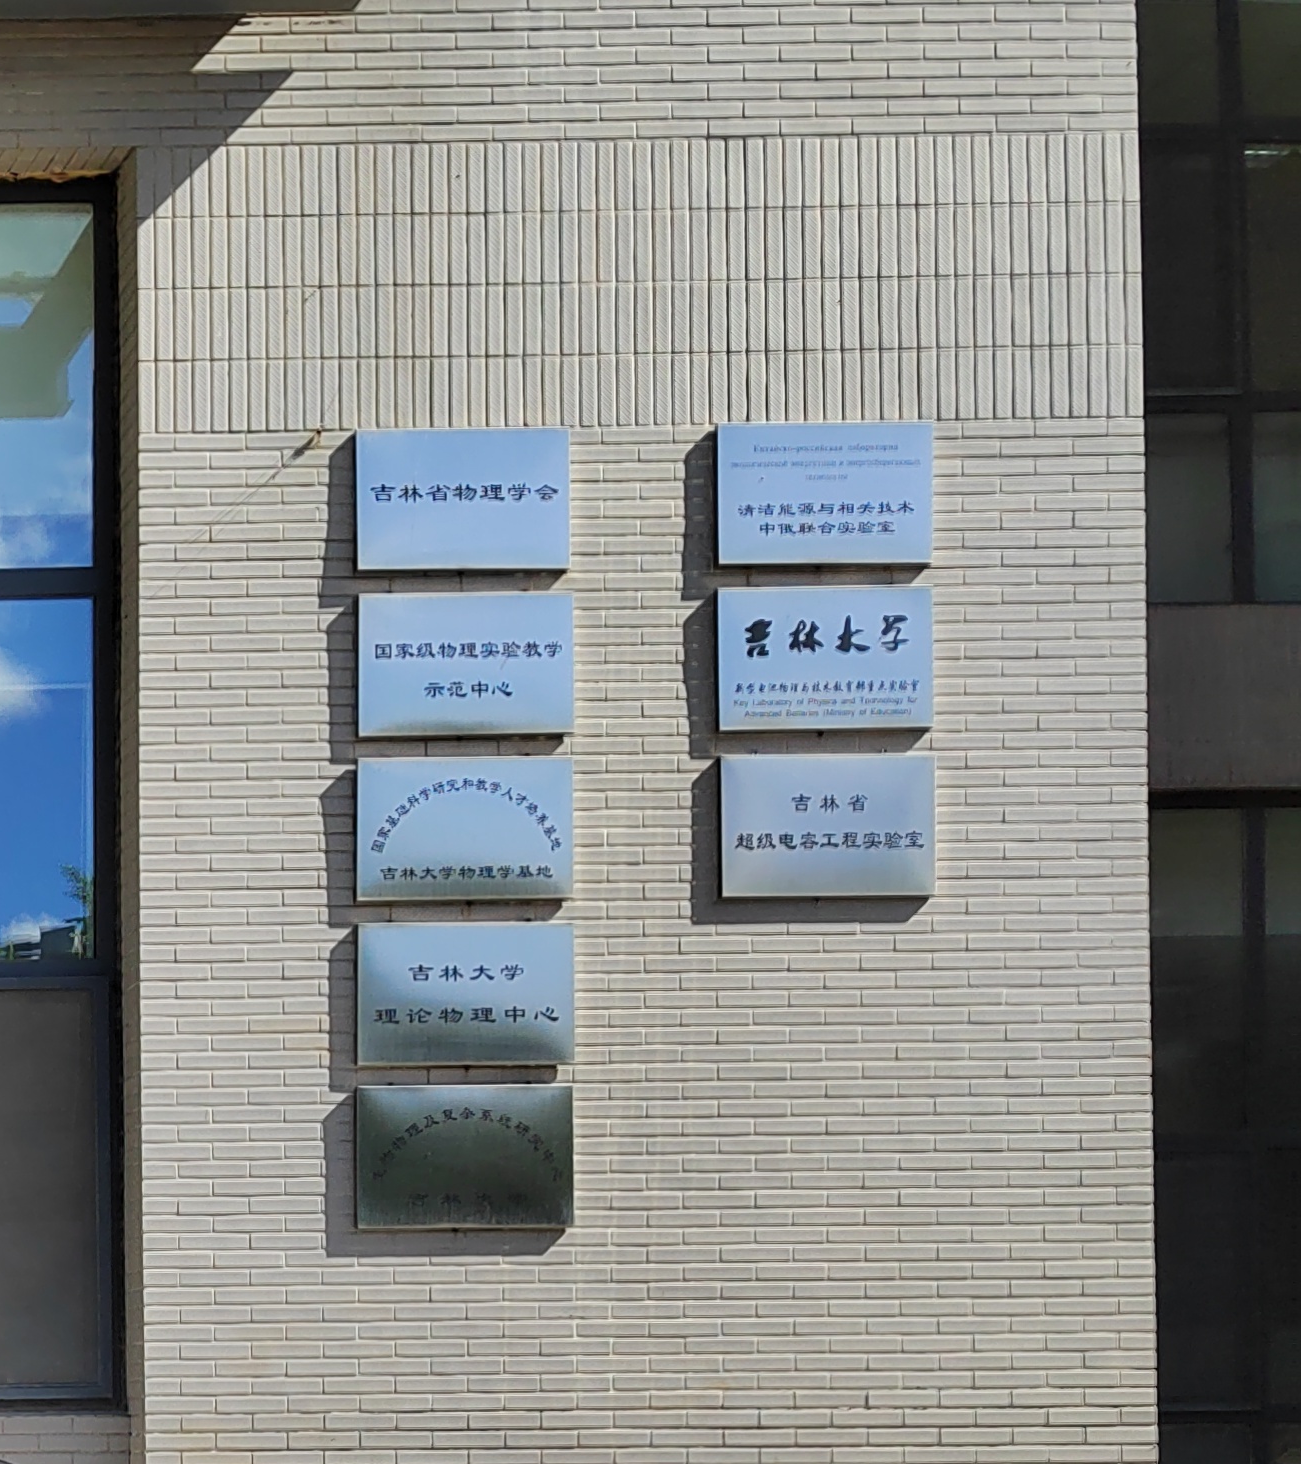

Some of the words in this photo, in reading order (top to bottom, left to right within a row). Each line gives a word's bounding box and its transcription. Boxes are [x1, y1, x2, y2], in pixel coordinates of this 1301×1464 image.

[370, 482, 560, 503] 吉林省物理学会
[737, 500, 915, 517] 清洁能源与相关技术
[759, 520, 896, 536] 中俄联合实验室
[744, 614, 910, 658] 吉林大学
[374, 640, 563, 660] 国家级物理实验教学
[423, 680, 514, 699] 示范中心
[791, 793, 869, 813] 吉林省
[370, 777, 563, 853] 国家基础科学研究和教学人才培养基地
[734, 830, 925, 851] 超级电容工程实验室
[380, 864, 554, 881] 吉林大学物理学基地
[408, 963, 524, 982] 吉林大学
[373, 1005, 560, 1024] 理论物理中心
